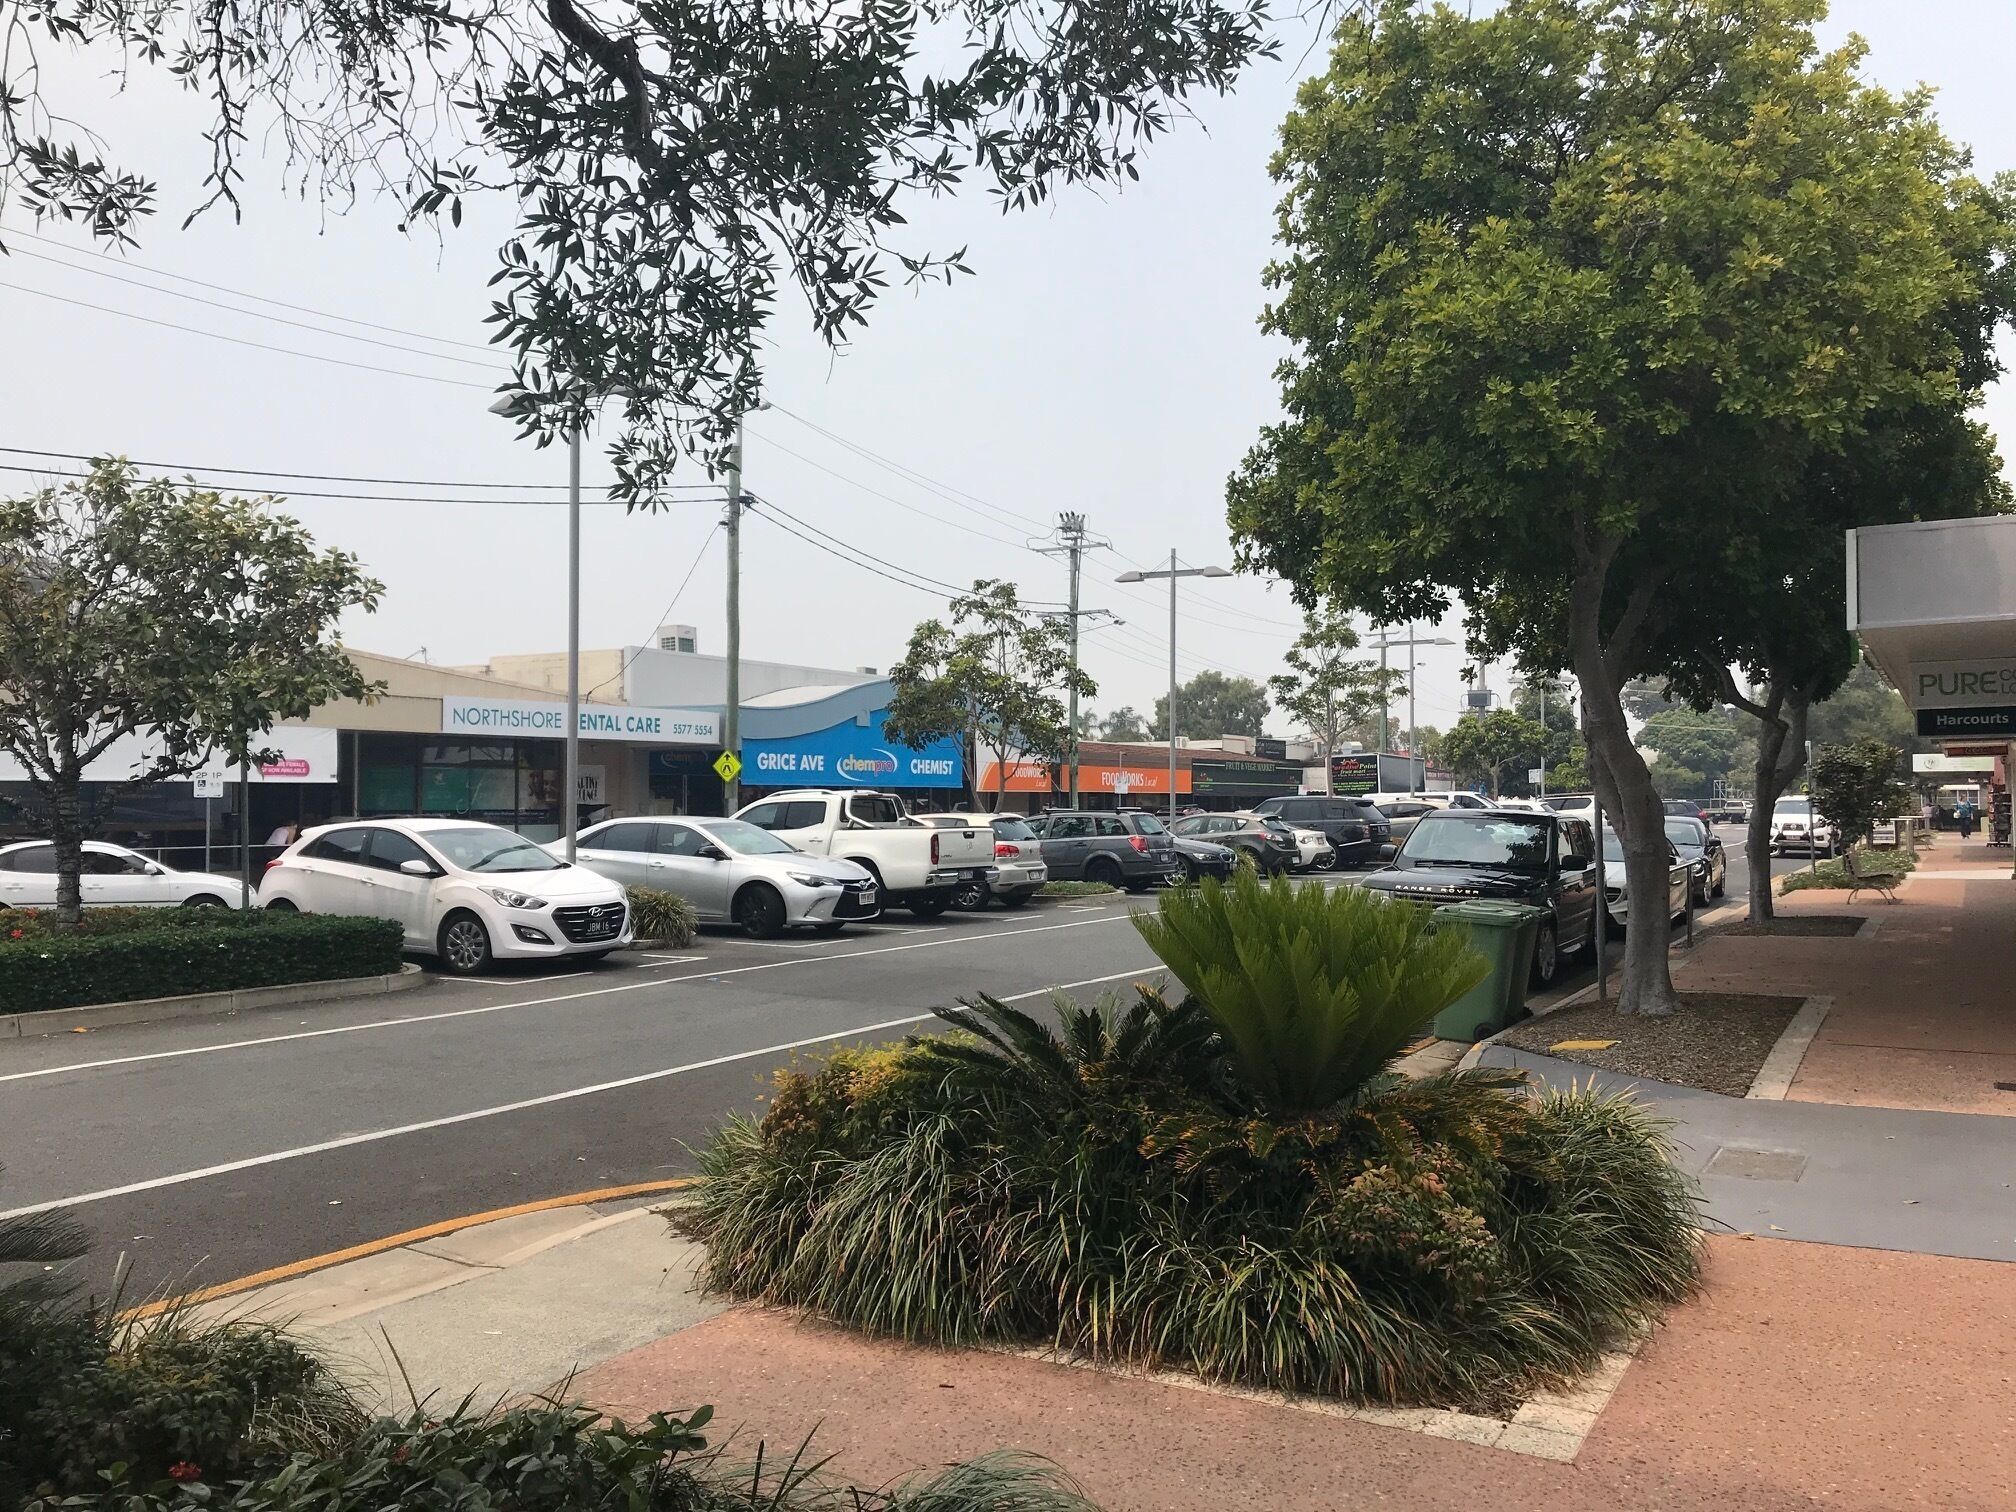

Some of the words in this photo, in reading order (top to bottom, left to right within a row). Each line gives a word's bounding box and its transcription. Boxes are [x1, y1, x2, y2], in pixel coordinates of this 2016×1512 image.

[1918, 670, 1998, 697] PURE
[452, 707, 562, 729] NORTHSHORE
[579, 713, 622, 732] ENTAL
[625, 716, 661, 734] CARE
[672, 723, 692, 735] 5577
[693, 725, 713, 736] 5554
[1936, 713, 2009, 726] Harcourts
[757, 752, 796, 771] GRICE
[799, 755, 824, 771] AVE
[842, 753, 894, 777] chempro
[910, 759, 954, 776] CHEMIST
[1225, 761, 1240, 771] FRUIT
[1245, 762, 1257, 771] VEGE
[1258, 763, 1276, 772] MARKET
[1440, 887, 1480, 895] ROVER
